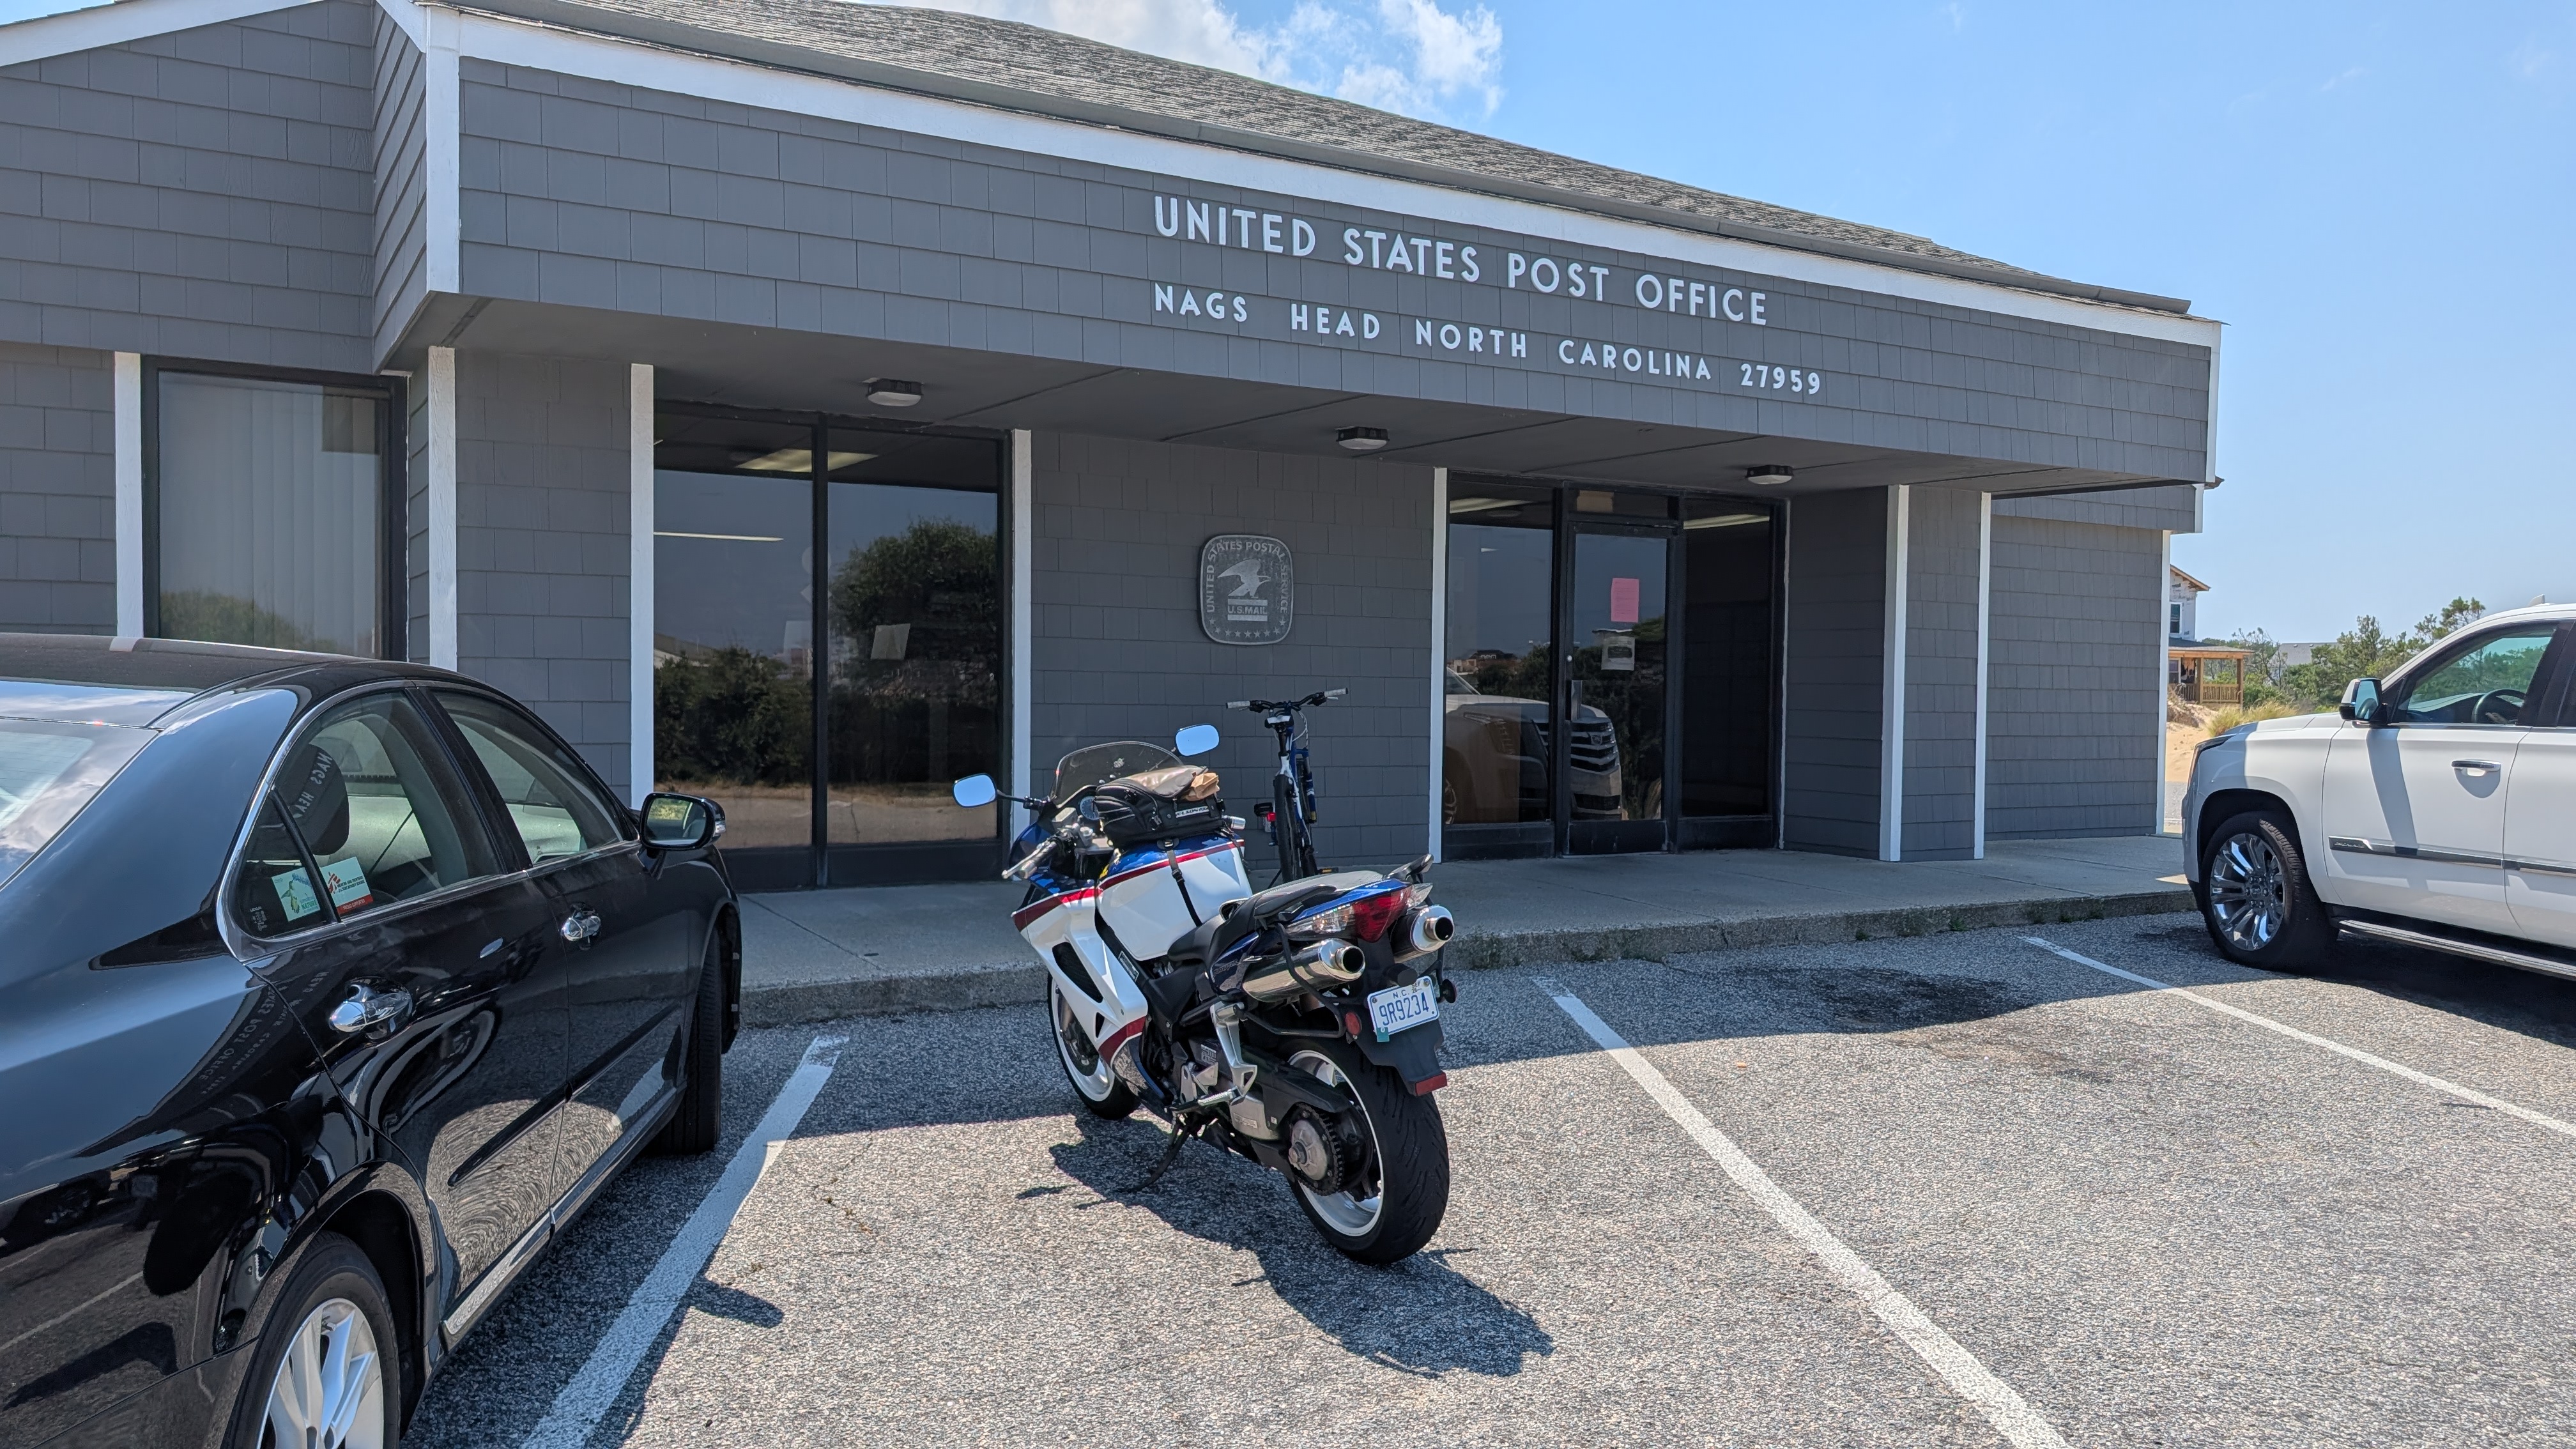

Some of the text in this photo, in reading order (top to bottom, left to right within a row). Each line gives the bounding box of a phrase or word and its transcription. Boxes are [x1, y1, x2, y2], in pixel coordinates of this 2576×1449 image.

[1154, 195, 1767, 326] UNITED STATES POST OFFICE
[1154, 282, 1820, 395] NAGS HEAD NORTH CAROLINA 27959
[1206, 541, 1289, 613] UNITED STATES POSTAL SERVICE
[1379, 992, 1429, 1026] 9R9234
[1393, 989, 1410, 999] N.C.
